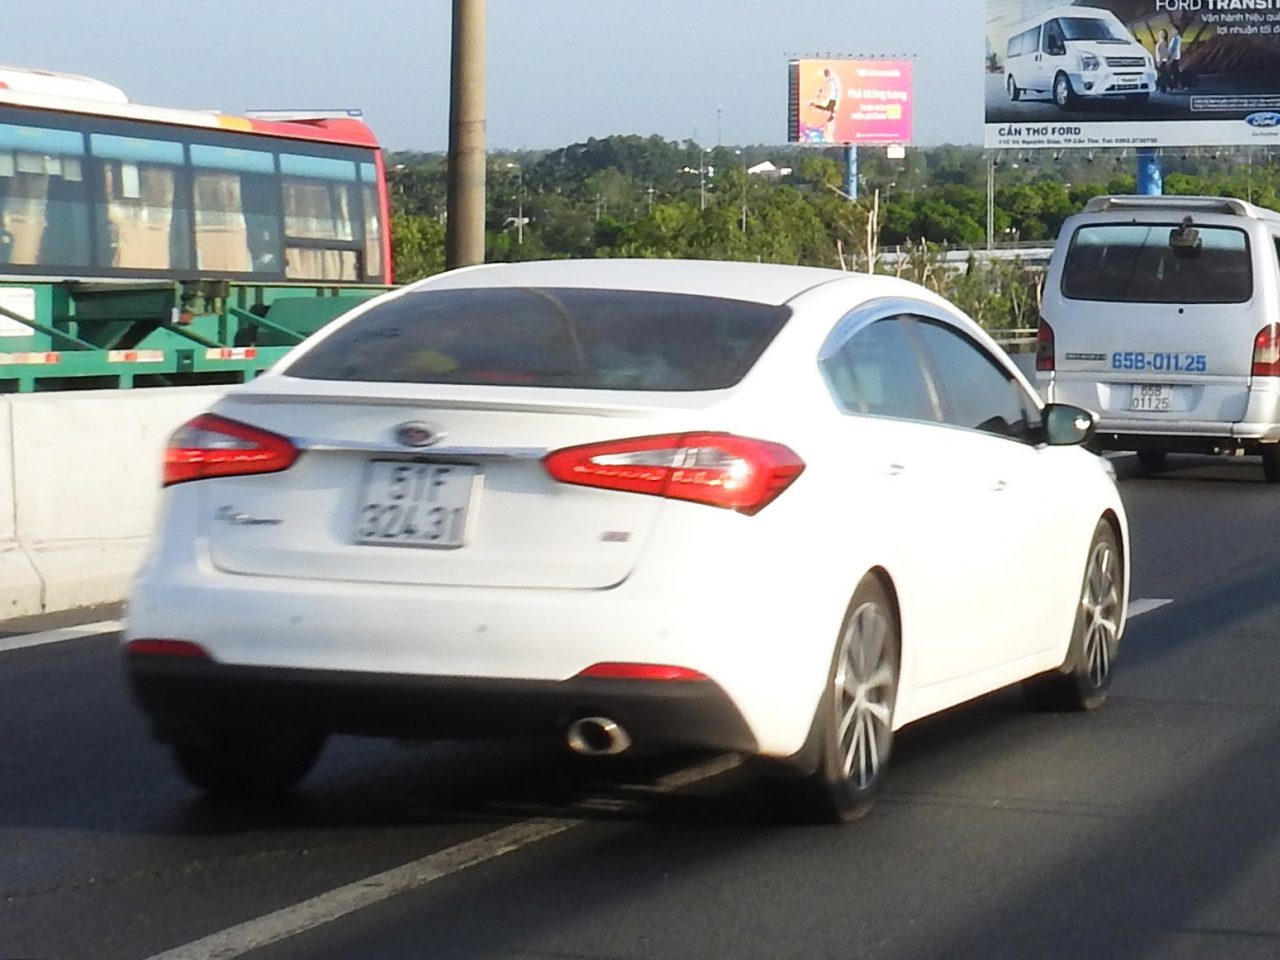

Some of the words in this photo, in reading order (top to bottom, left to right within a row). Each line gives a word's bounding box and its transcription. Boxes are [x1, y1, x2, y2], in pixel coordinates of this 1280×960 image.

[1052, 126, 1082, 136] FORD
[1112, 352, 1207, 372] 65B-011.25
[1140, 384, 1162, 397] 65B
[391, 466, 451, 503] 51F
